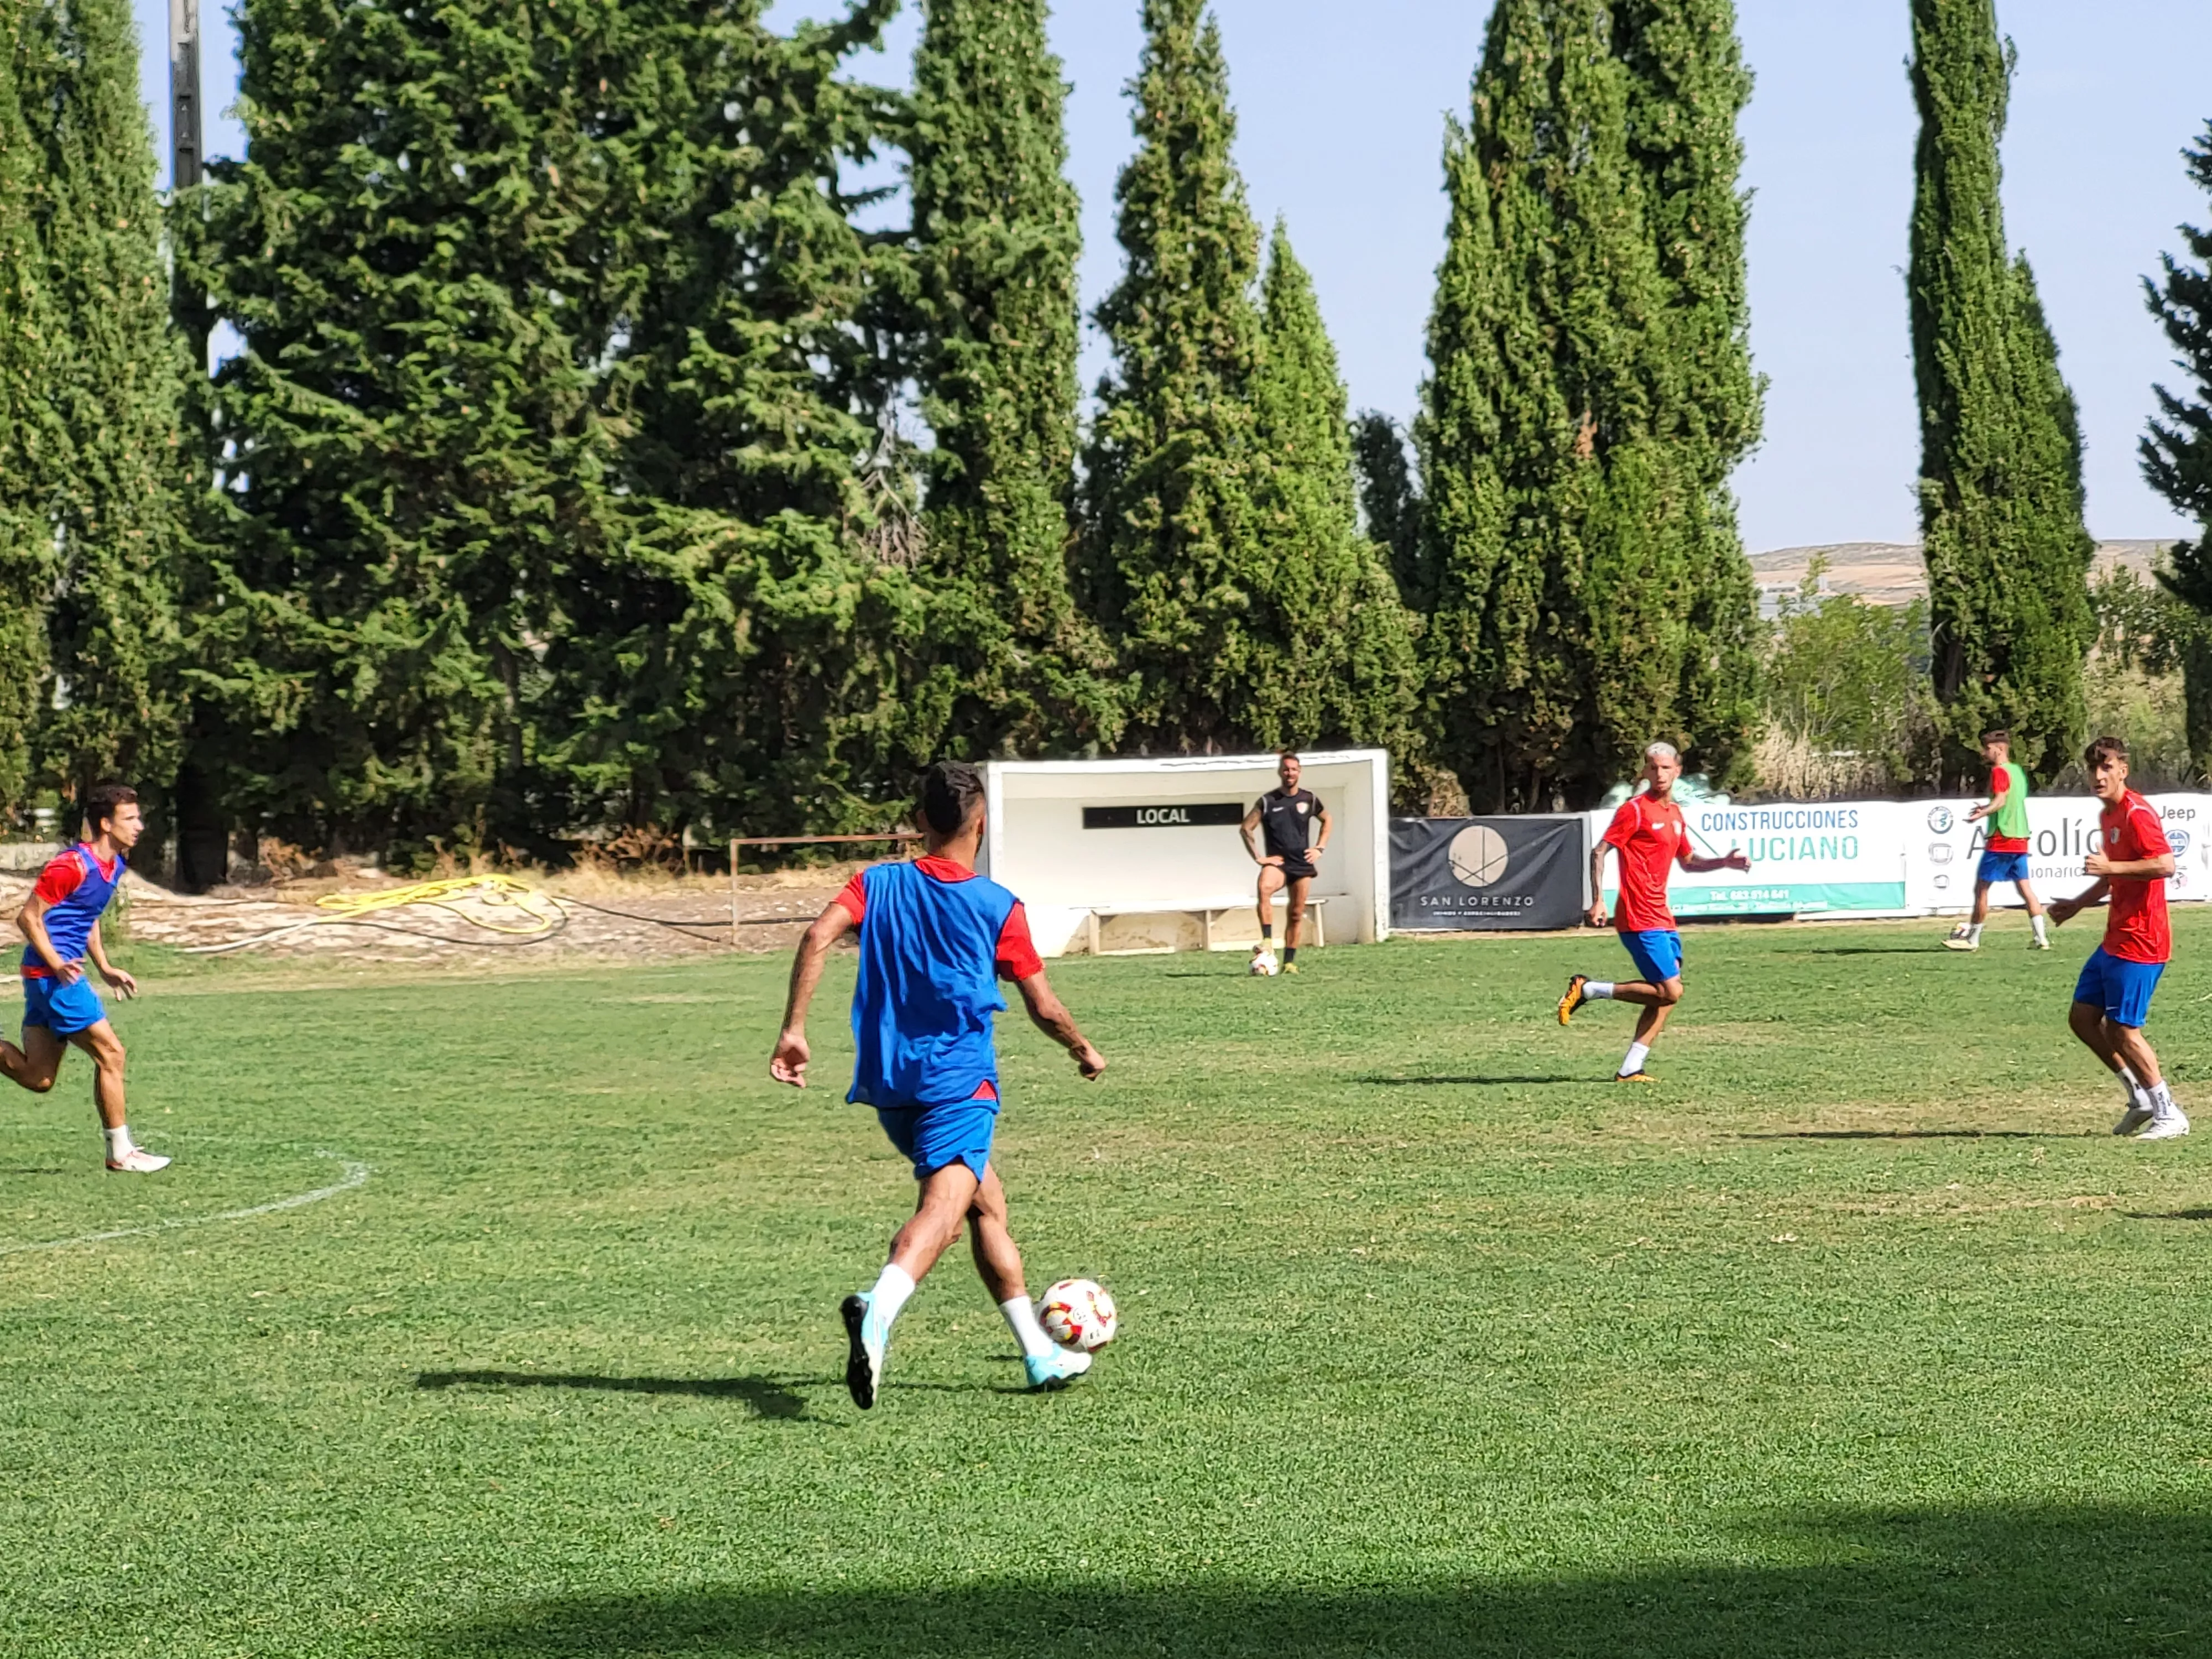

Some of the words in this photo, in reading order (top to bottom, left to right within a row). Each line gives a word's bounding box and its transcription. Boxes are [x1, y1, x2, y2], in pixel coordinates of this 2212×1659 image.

[1136, 808, 1191, 824] LOCAL
[1702, 810, 1858, 831] CONSTRUCCIONES
[2160, 805, 2196, 821] Jeep
[1420, 896, 1451, 906] SAN
[1459, 896, 1534, 906] LORENZO
